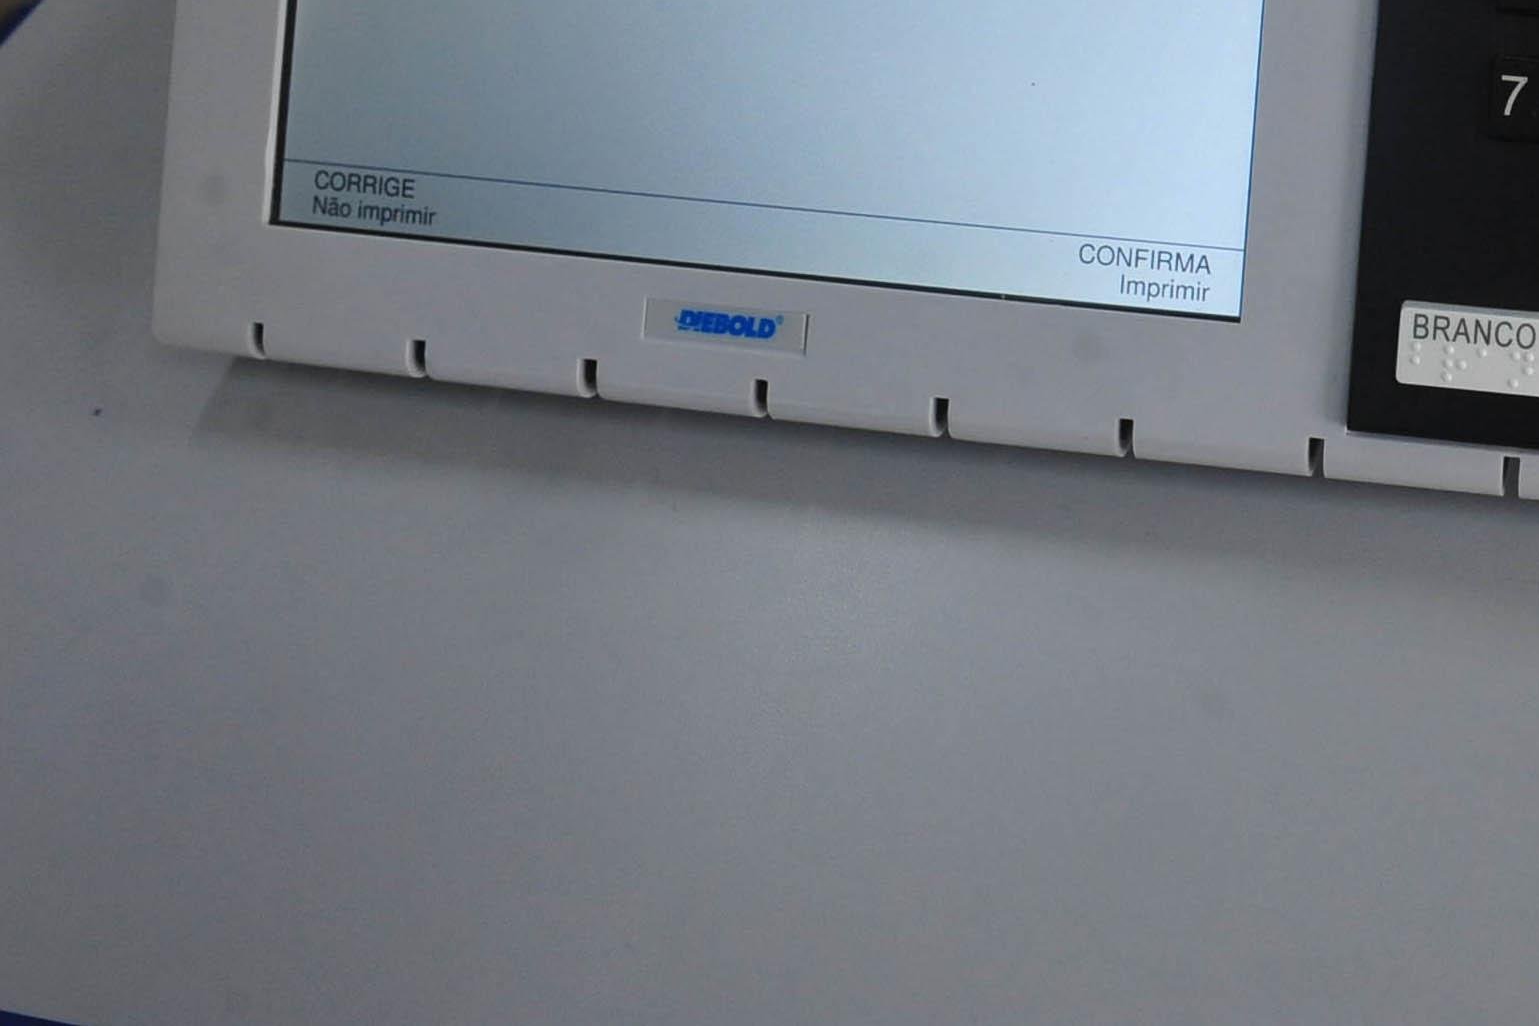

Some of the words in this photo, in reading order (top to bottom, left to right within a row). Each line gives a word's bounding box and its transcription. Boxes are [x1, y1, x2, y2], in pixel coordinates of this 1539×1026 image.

[1501, 74, 1529, 116] 7
[314, 170, 416, 200] CORRIGE
[312, 196, 352, 219] Não
[356, 202, 437, 228] imprimir
[1078, 243, 1212, 275] CONFIRMA
[1120, 273, 1211, 302] Imprimir
[1412, 313, 1538, 351] BRANCO
